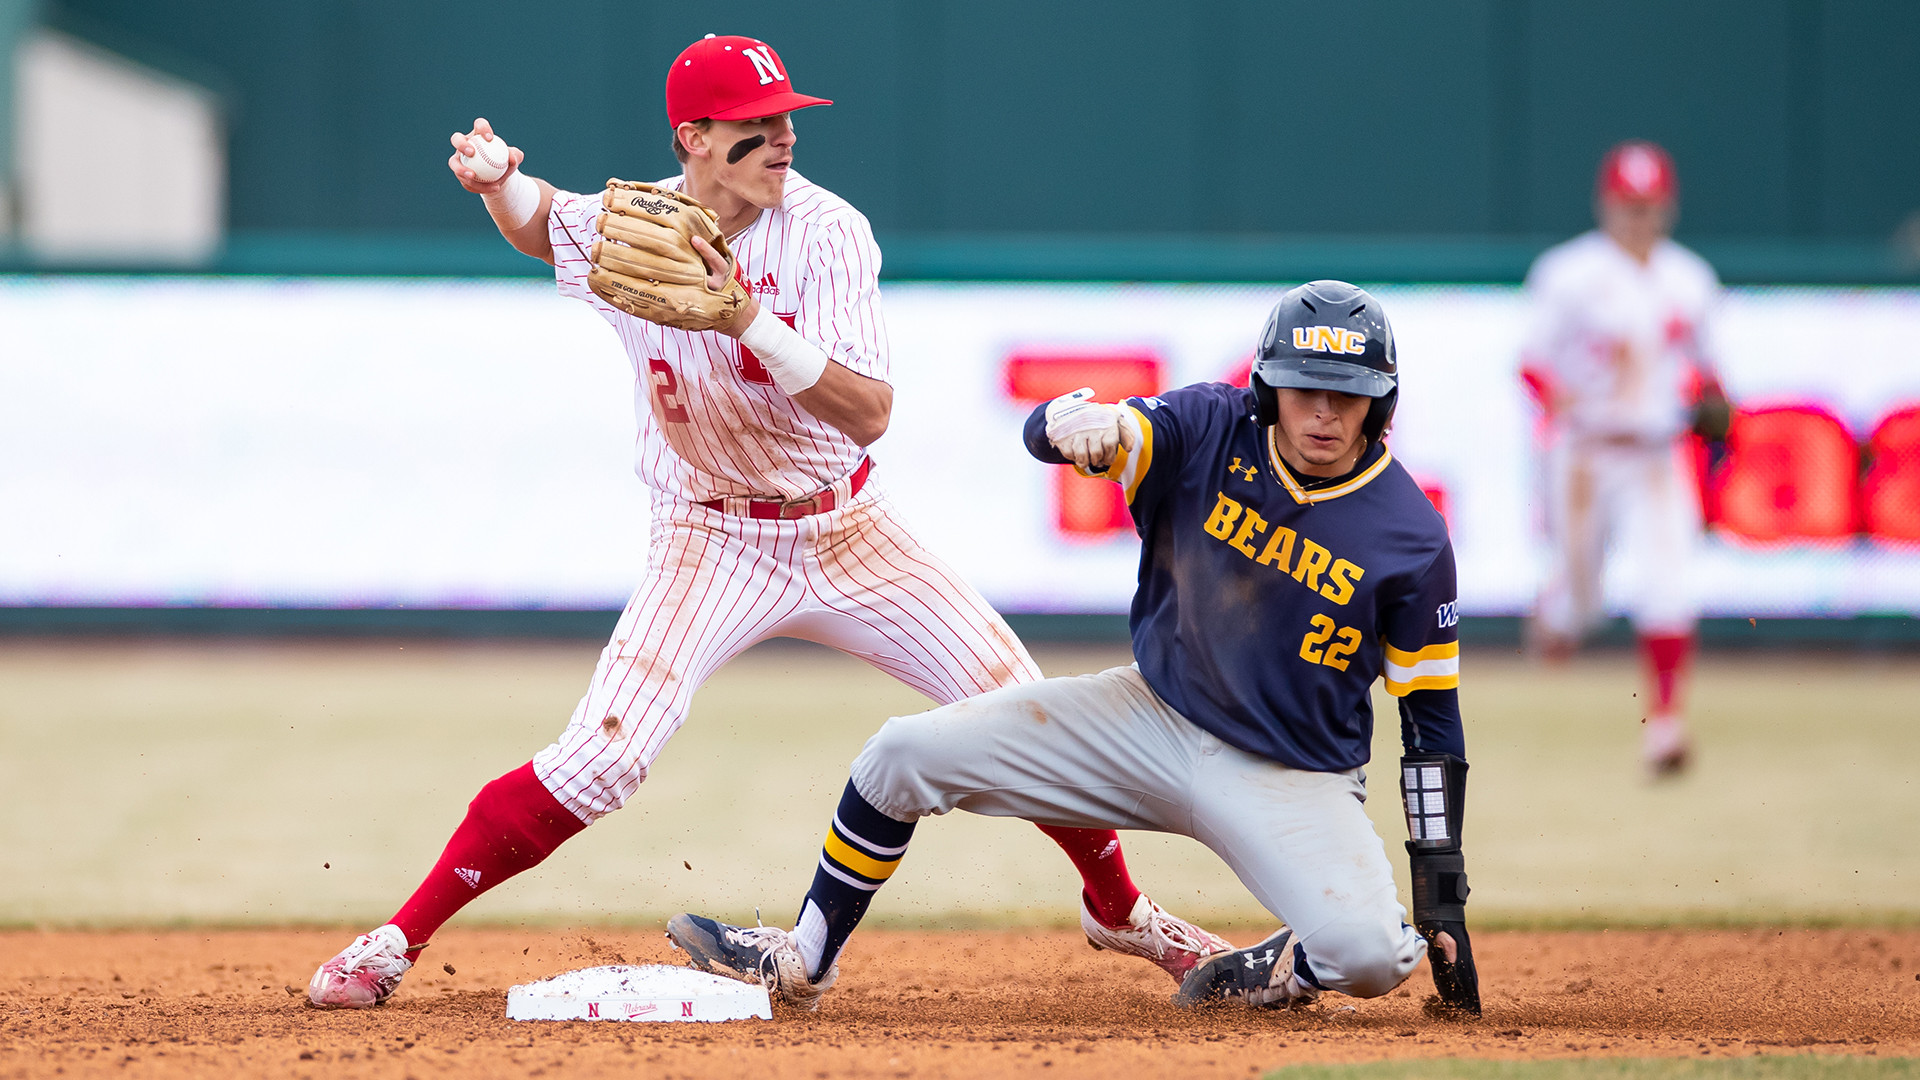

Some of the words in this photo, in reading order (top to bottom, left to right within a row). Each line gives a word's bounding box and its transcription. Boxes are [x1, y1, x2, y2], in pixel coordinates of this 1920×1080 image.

[741, 45, 785, 86] N
[631, 197, 680, 215] Rawlings
[611, 280, 623, 289] THE
[623, 285, 638, 295] GOLD
[639, 290, 657, 301] GLOVE
[1292, 326, 1366, 354] UNC
[648, 358, 691, 424] 2
[1203, 491, 1365, 606] BEARS
[1299, 613, 1363, 673] 22
[454, 867, 478, 889] adidas
[588, 1002, 600, 1018] N
[623, 1001, 658, 1015] Nebraska
[681, 1001, 693, 1017] N
